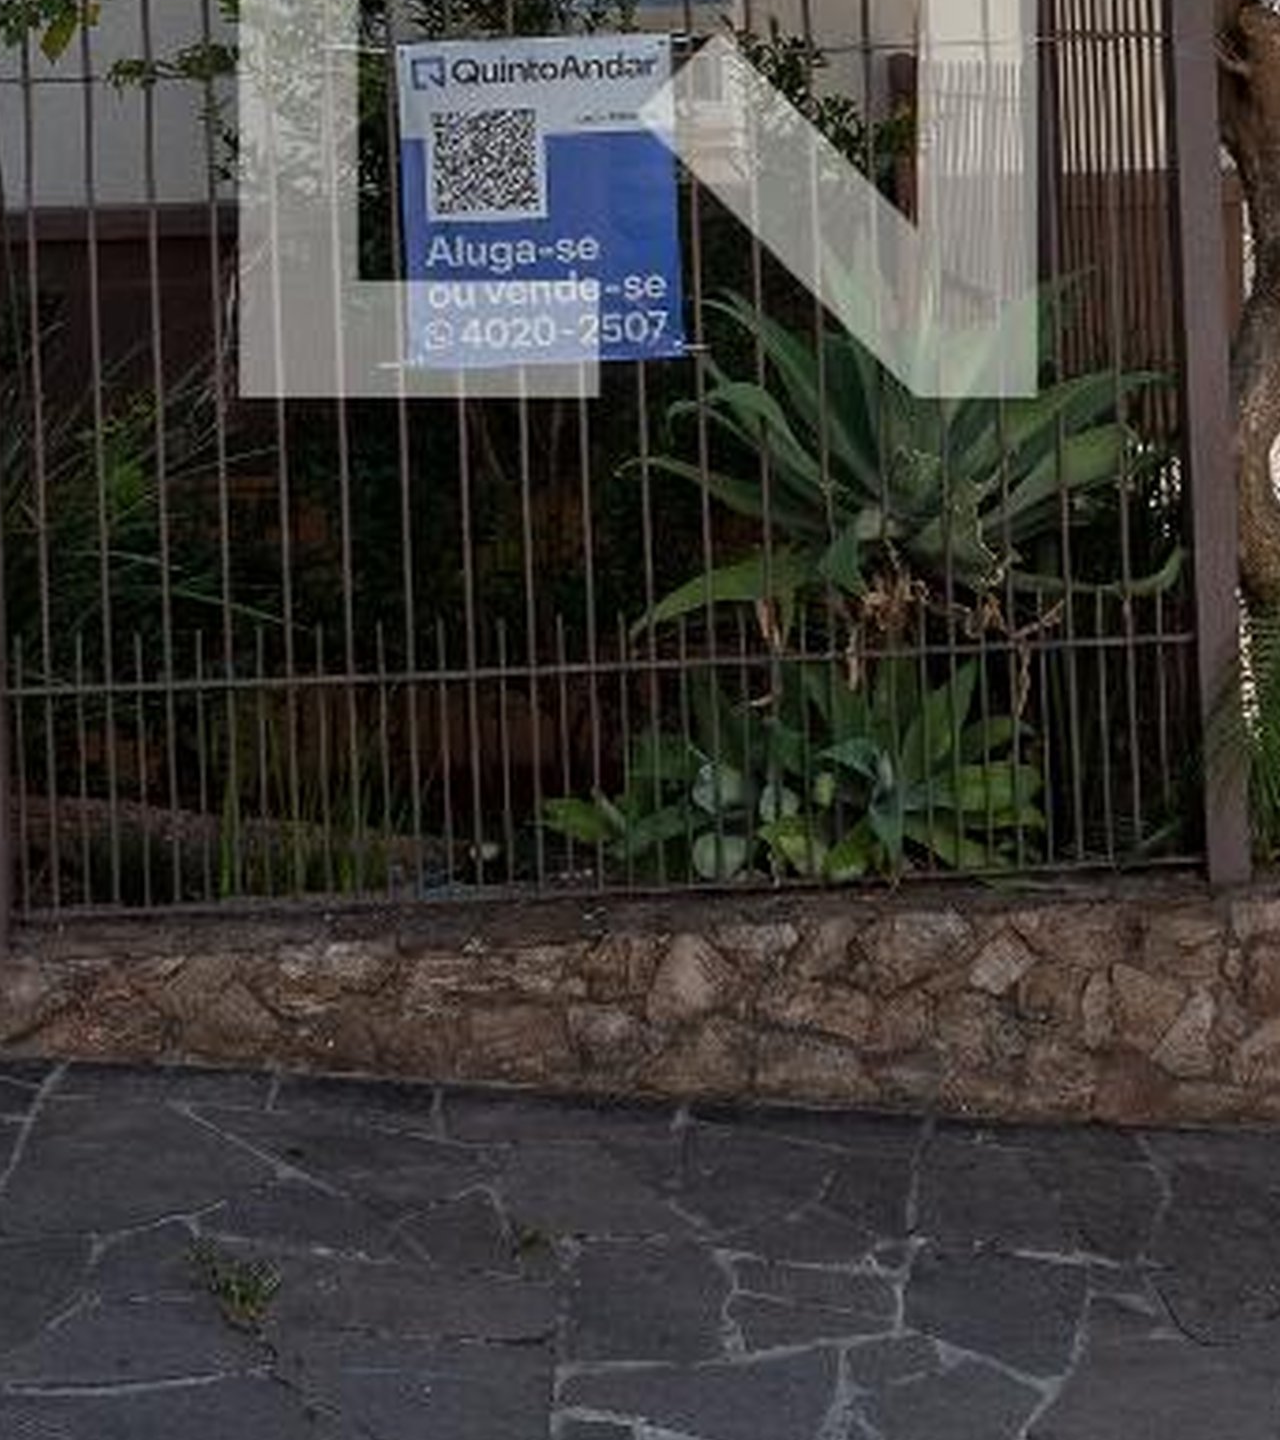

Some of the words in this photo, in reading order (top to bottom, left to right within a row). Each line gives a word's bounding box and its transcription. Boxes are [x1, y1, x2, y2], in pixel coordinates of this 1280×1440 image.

[451, 51, 657, 86] QuintoAndar
[425, 235, 600, 273] Aluga-se
[428, 282, 475, 310] ou
[486, 270, 668, 306] vende-se
[460, 310, 669, 349] 4020-2507
